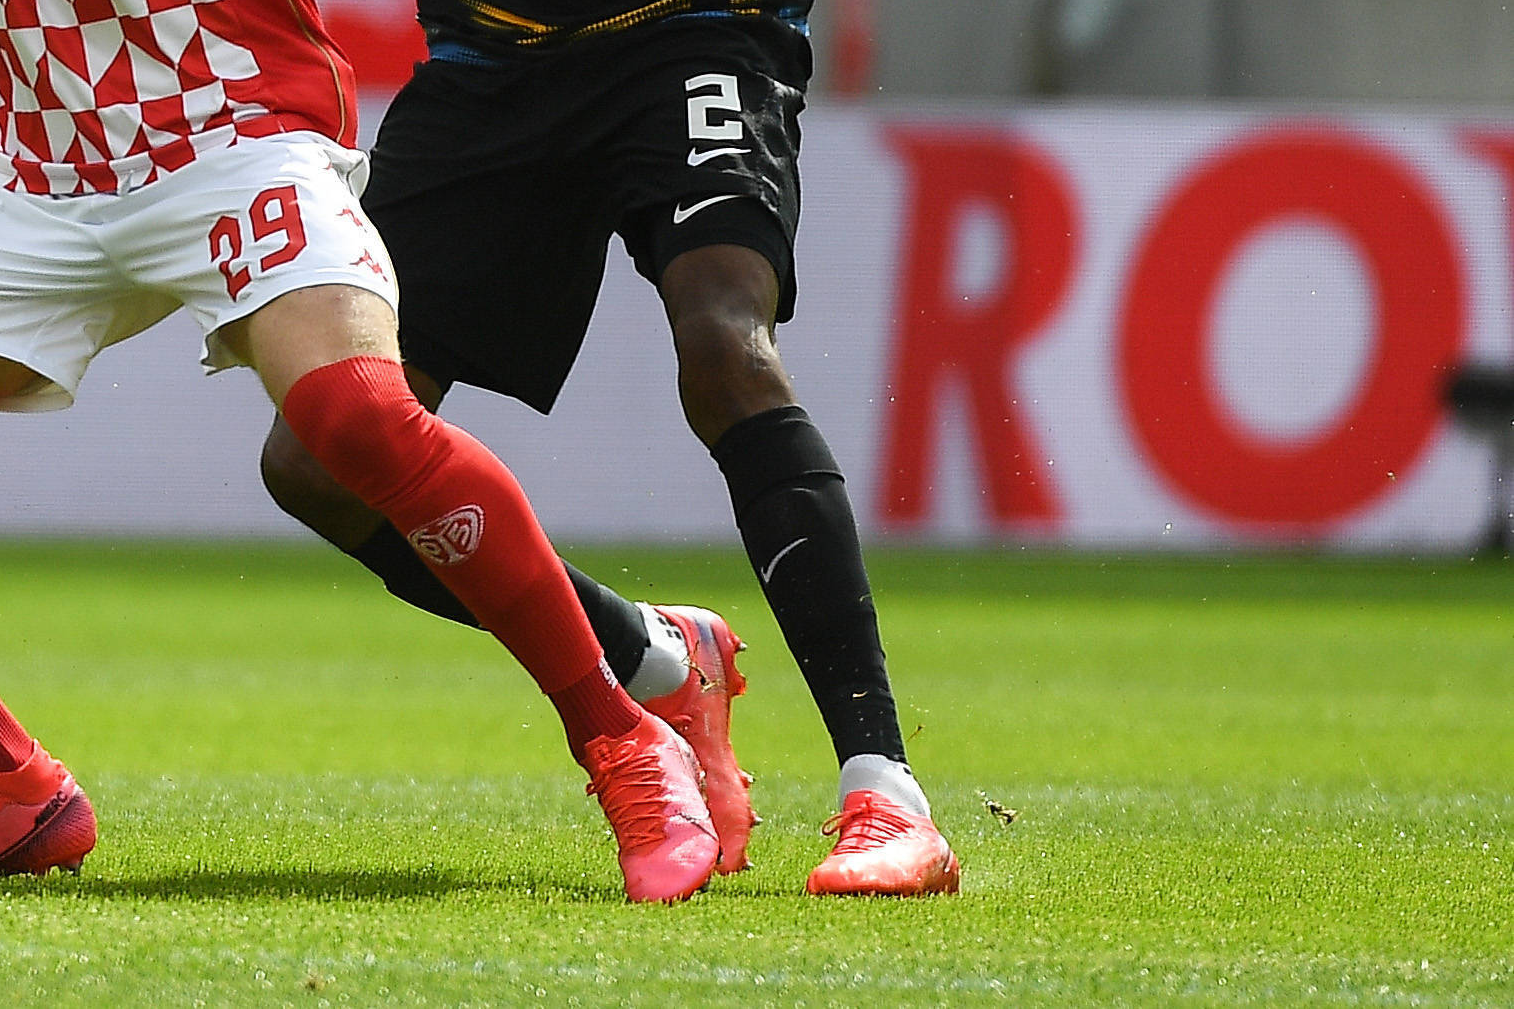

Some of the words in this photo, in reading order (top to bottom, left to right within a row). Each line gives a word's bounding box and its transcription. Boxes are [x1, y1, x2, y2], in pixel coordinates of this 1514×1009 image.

[685, 73, 743, 140] 2
[208, 184, 308, 303] 29
[874, 118, 1514, 538] RO
